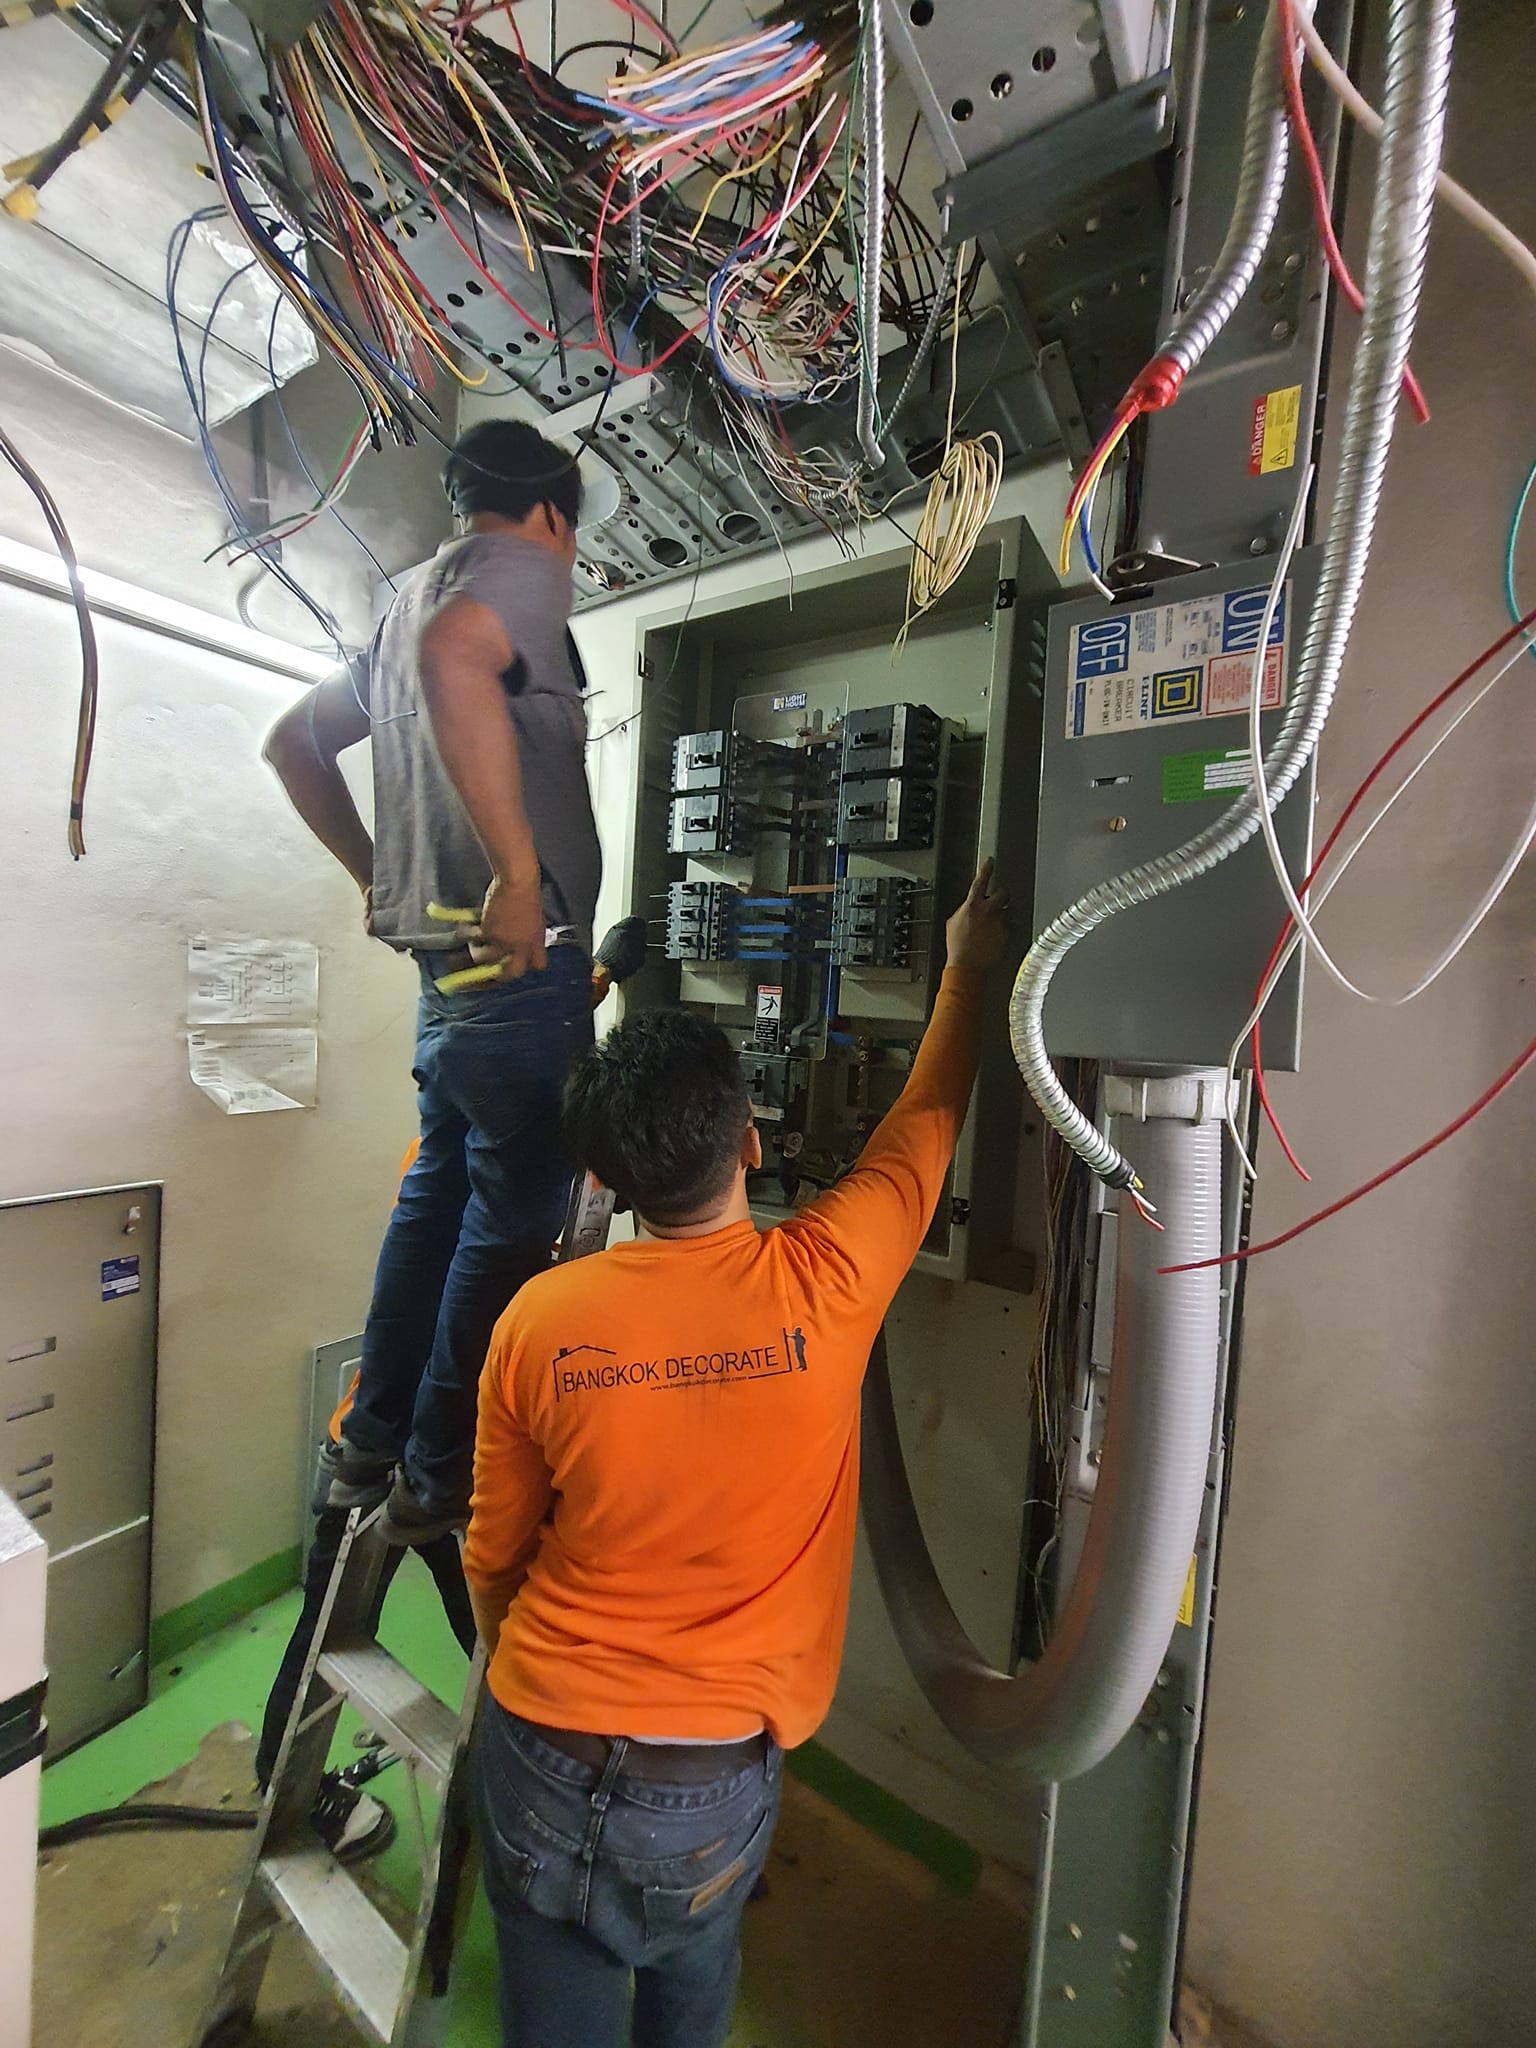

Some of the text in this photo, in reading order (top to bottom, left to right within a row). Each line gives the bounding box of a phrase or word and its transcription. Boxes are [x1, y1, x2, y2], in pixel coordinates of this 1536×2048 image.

[1251, 405, 1266, 457] DANGER
[1227, 589, 1283, 648] ON
[1081, 621, 1127, 672] OFF
[1114, 680, 1123, 722] BREAKER
[1125, 678, 1135, 720] CIRCUIT
[1265, 663, 1277, 700] DANGER
[563, 1346, 779, 1393] BANGKOK DECORATE
